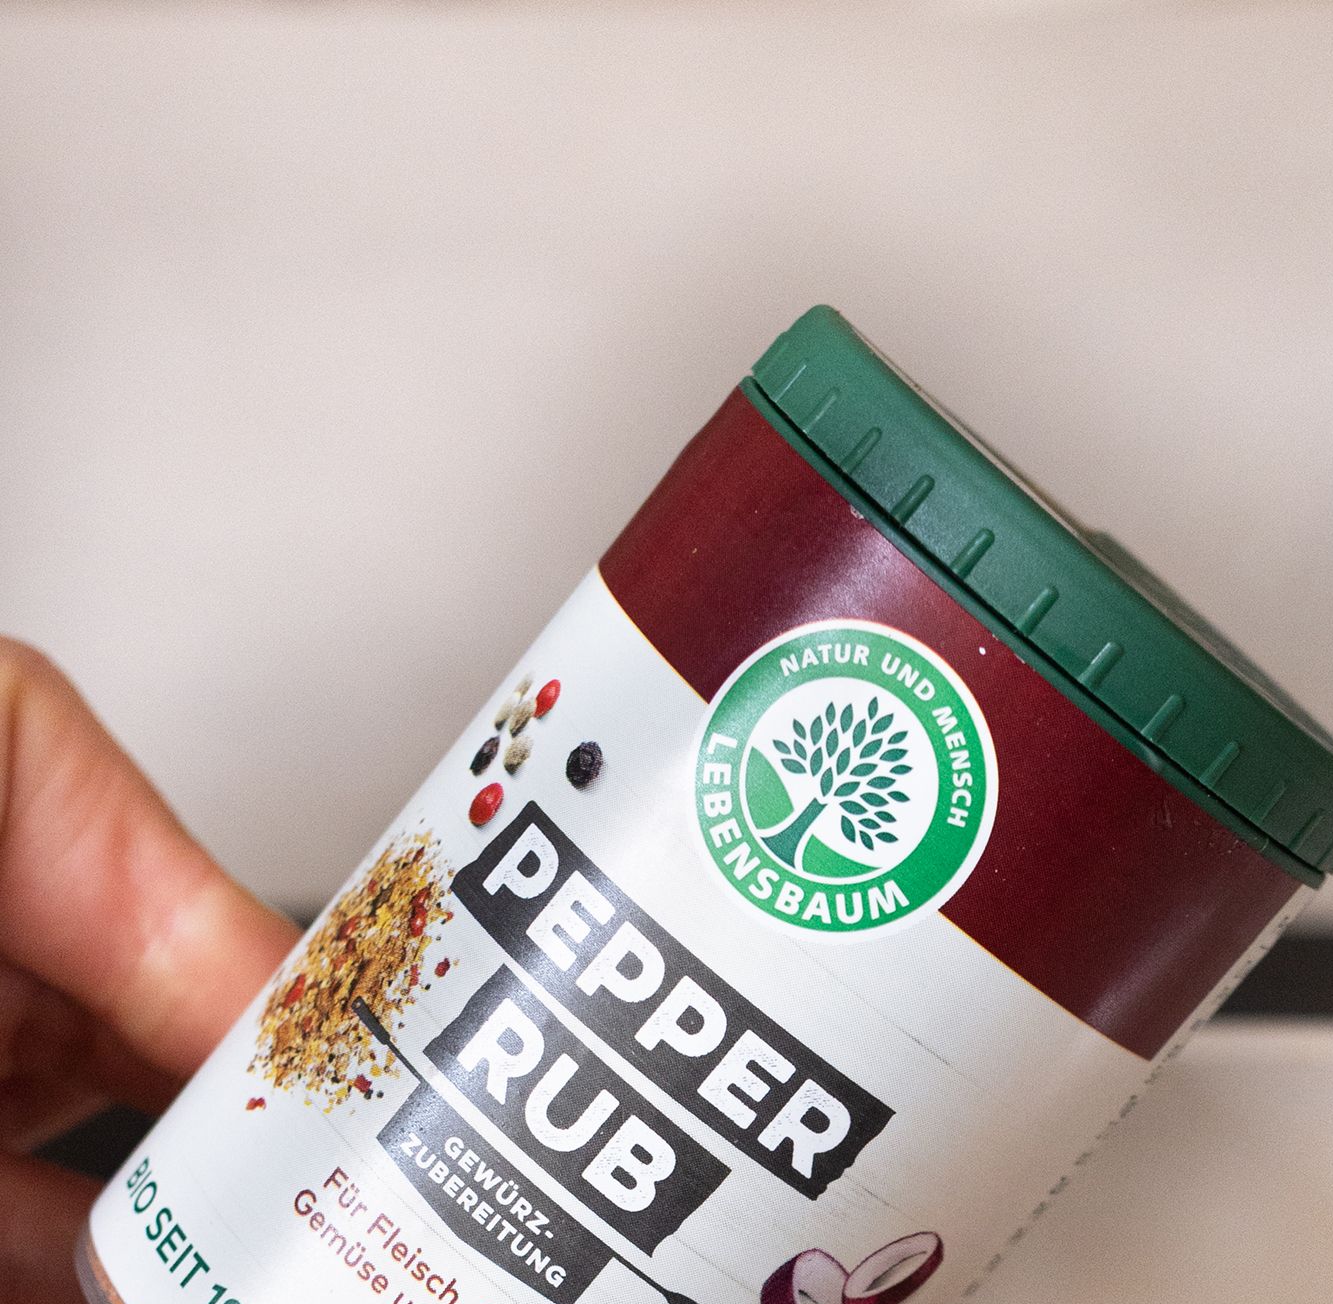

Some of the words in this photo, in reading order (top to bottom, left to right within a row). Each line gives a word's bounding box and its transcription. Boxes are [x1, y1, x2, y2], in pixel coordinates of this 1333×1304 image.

[779, 643, 870, 677] NATUR
[880, 653, 937, 701] UND
[931, 706, 973, 828] MENSCH
[703, 732, 910, 925] LEBENSBAUM
[482, 823, 852, 1179] PEPPER
[456, 998, 677, 1213] RUB
[125, 1156, 158, 1214] BIO
[145, 1206, 210, 1289] SEIT
[293, 1188, 390, 1295] Gemüse
[322, 1166, 369, 1218] Für
[400, 1131, 567, 1289] ZUBEREITUNG
[443, 1136, 556, 1241] GEWÜRZ-
